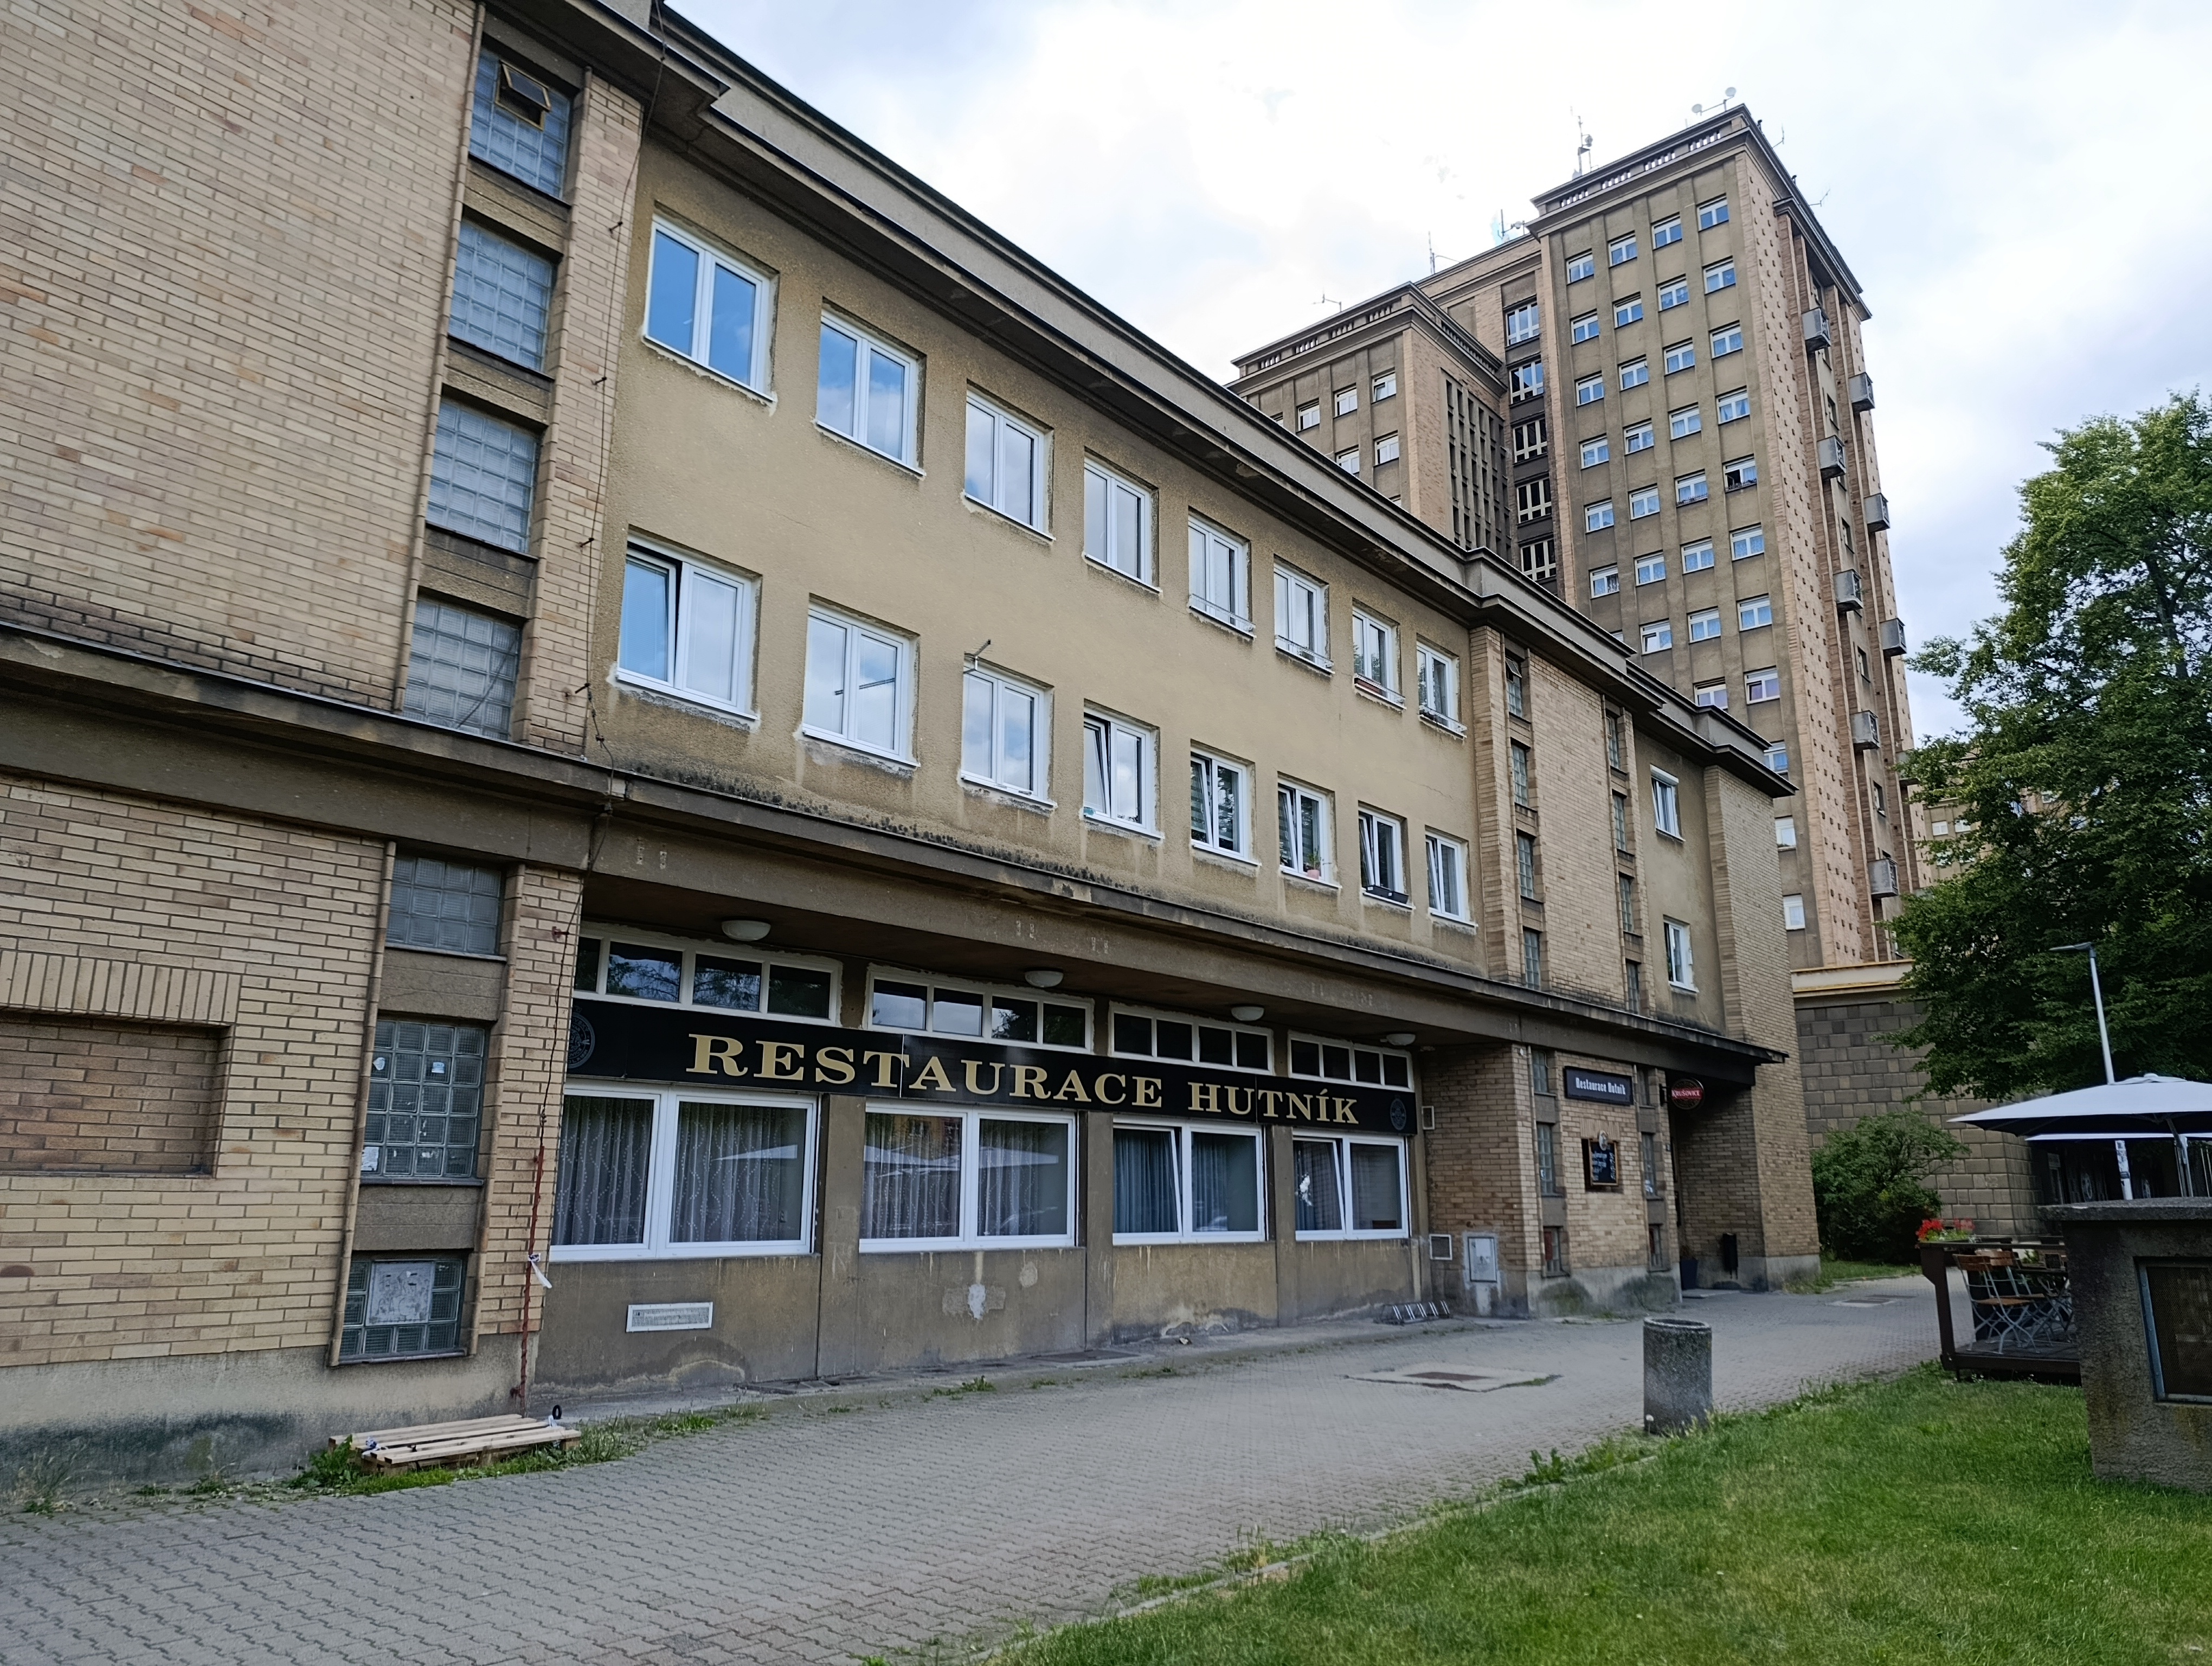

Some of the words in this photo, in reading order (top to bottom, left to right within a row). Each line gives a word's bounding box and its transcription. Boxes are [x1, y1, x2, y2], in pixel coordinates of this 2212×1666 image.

[686, 1034, 1162, 1107] RESTAURACE
[1187, 1082, 1358, 1124] HUTNÍK
[1576, 1077, 1606, 1092] Restaurace
